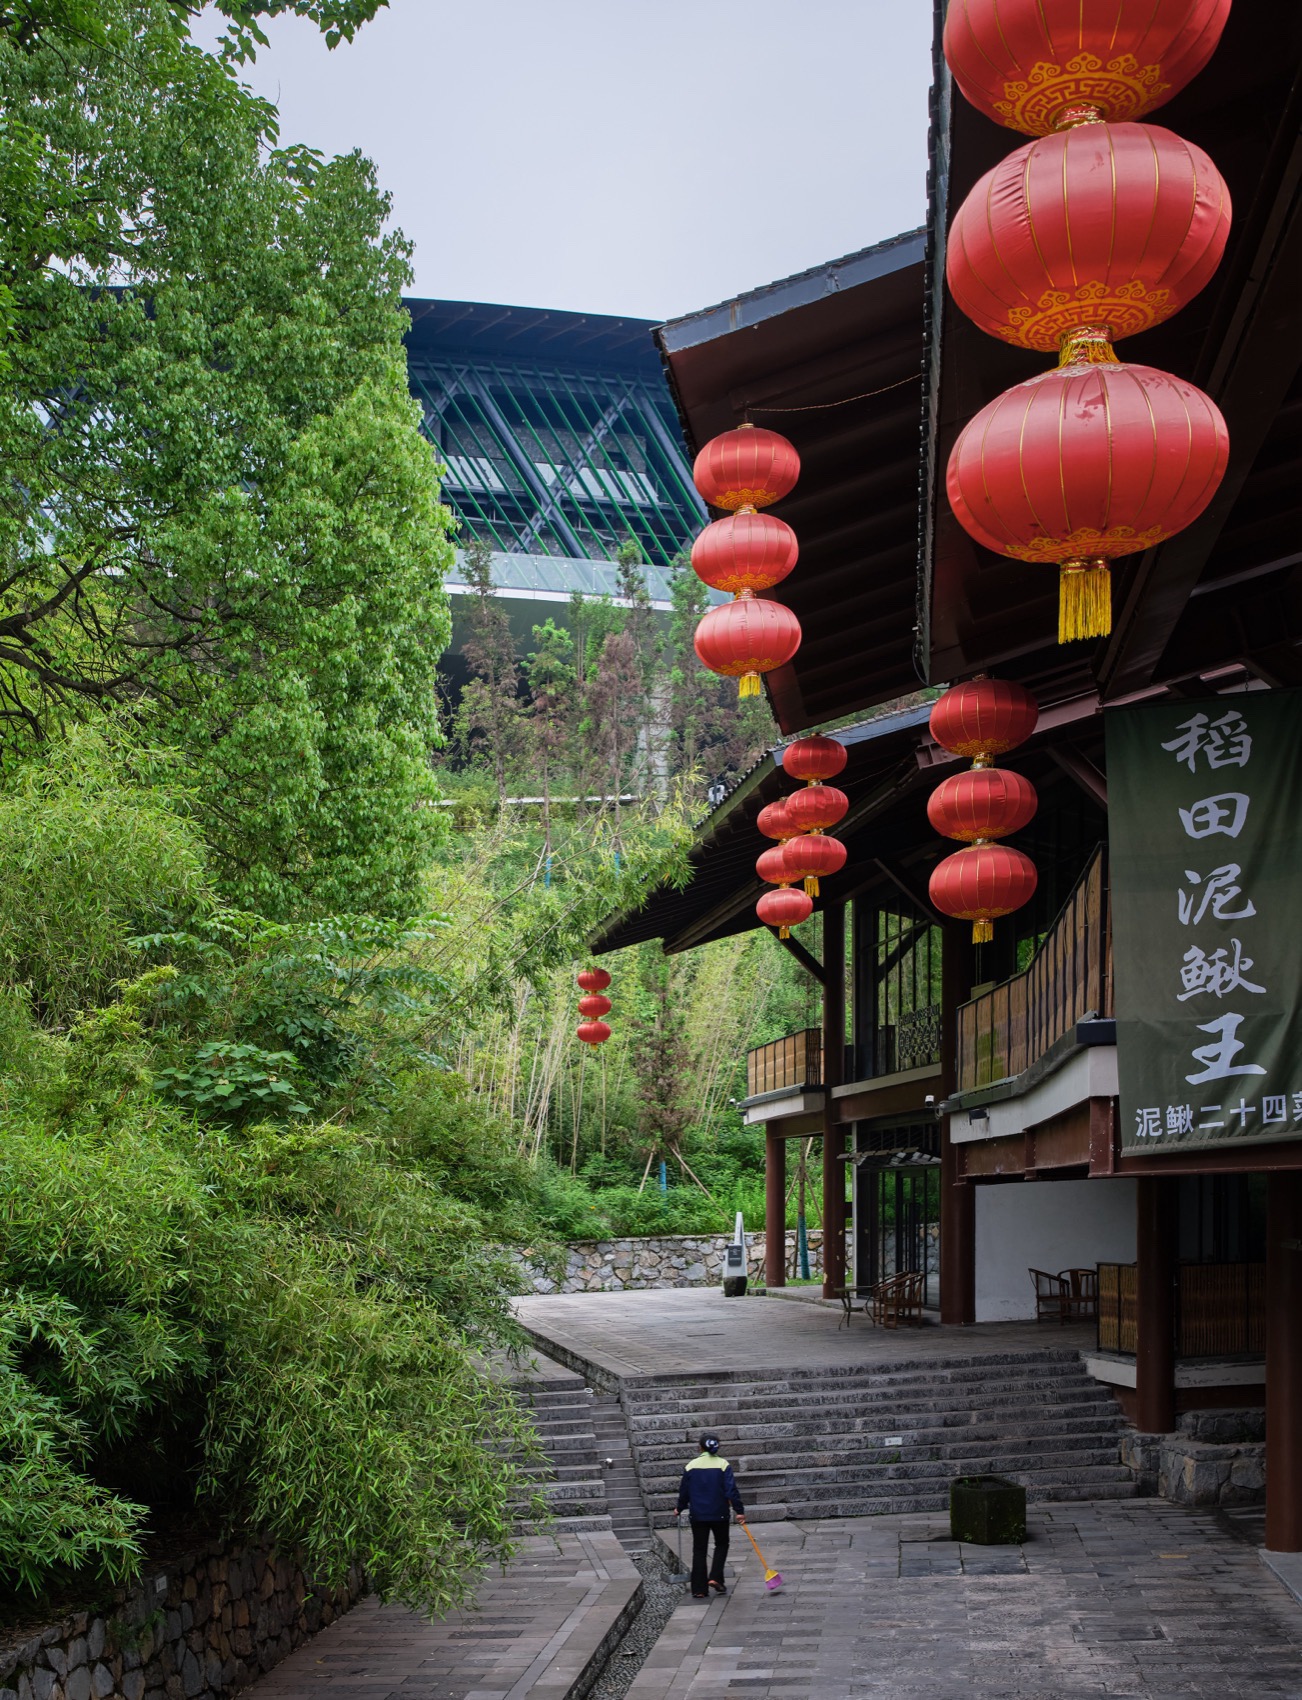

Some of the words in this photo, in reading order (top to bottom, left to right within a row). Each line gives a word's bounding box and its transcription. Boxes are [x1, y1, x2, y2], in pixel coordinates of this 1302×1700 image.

[1161, 711, 1267, 1085] 稻田泥鳅王
